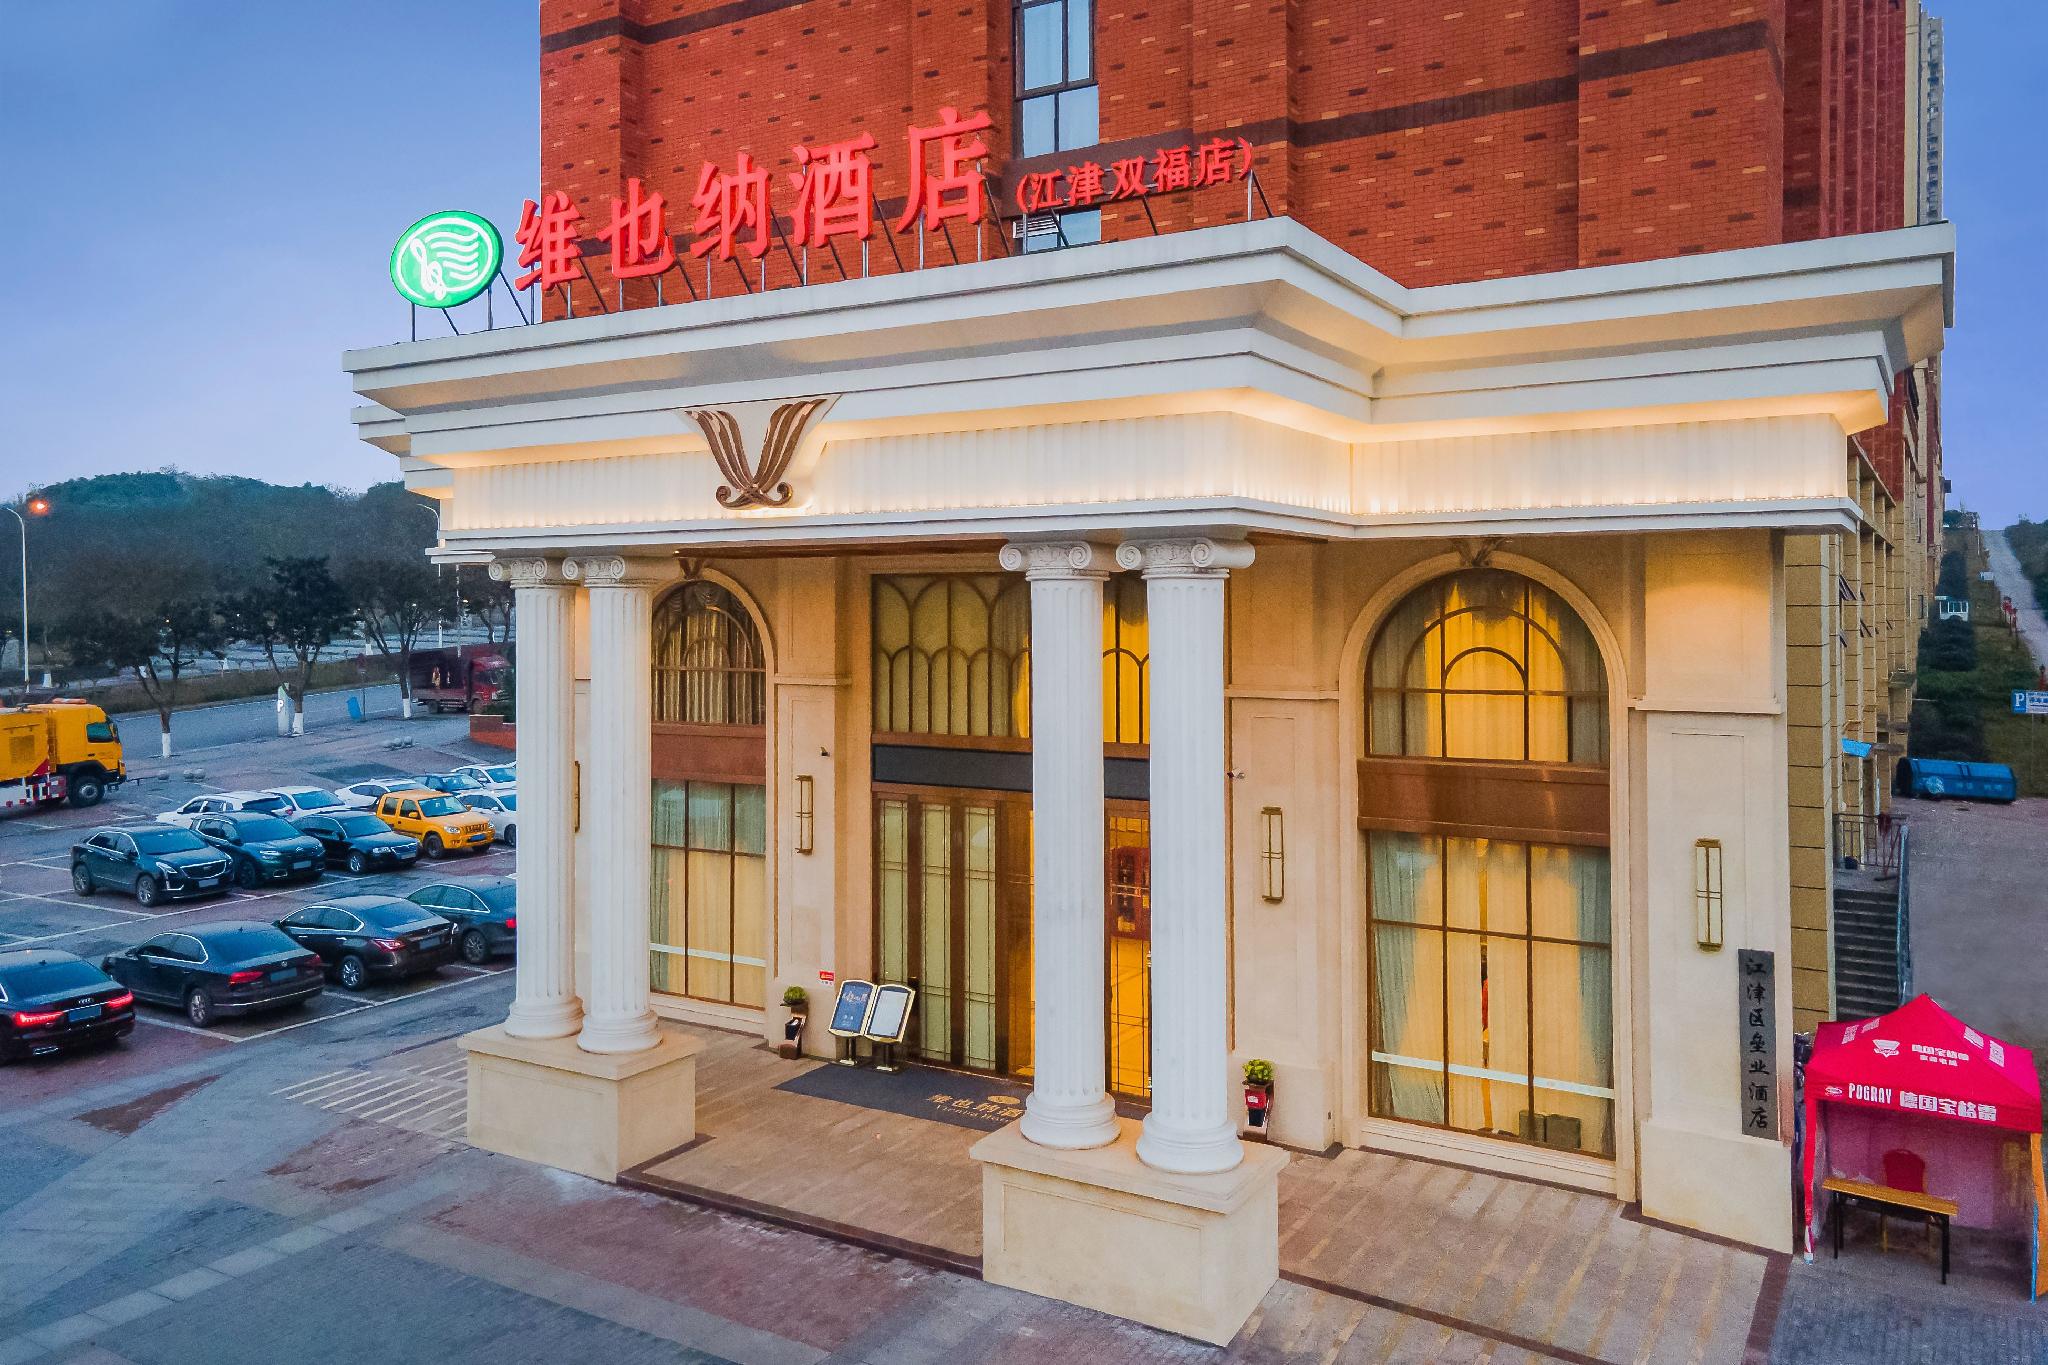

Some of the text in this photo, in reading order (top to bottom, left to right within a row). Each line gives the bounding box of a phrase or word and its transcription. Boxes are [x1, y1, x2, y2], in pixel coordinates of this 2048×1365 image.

[515, 106, 993, 291] 维也纳酒店
[1015, 136, 1253, 213] (江津双福店)
[2015, 692, 2025, 707] P
[1848, 1083, 1892, 1105] POGRAY
